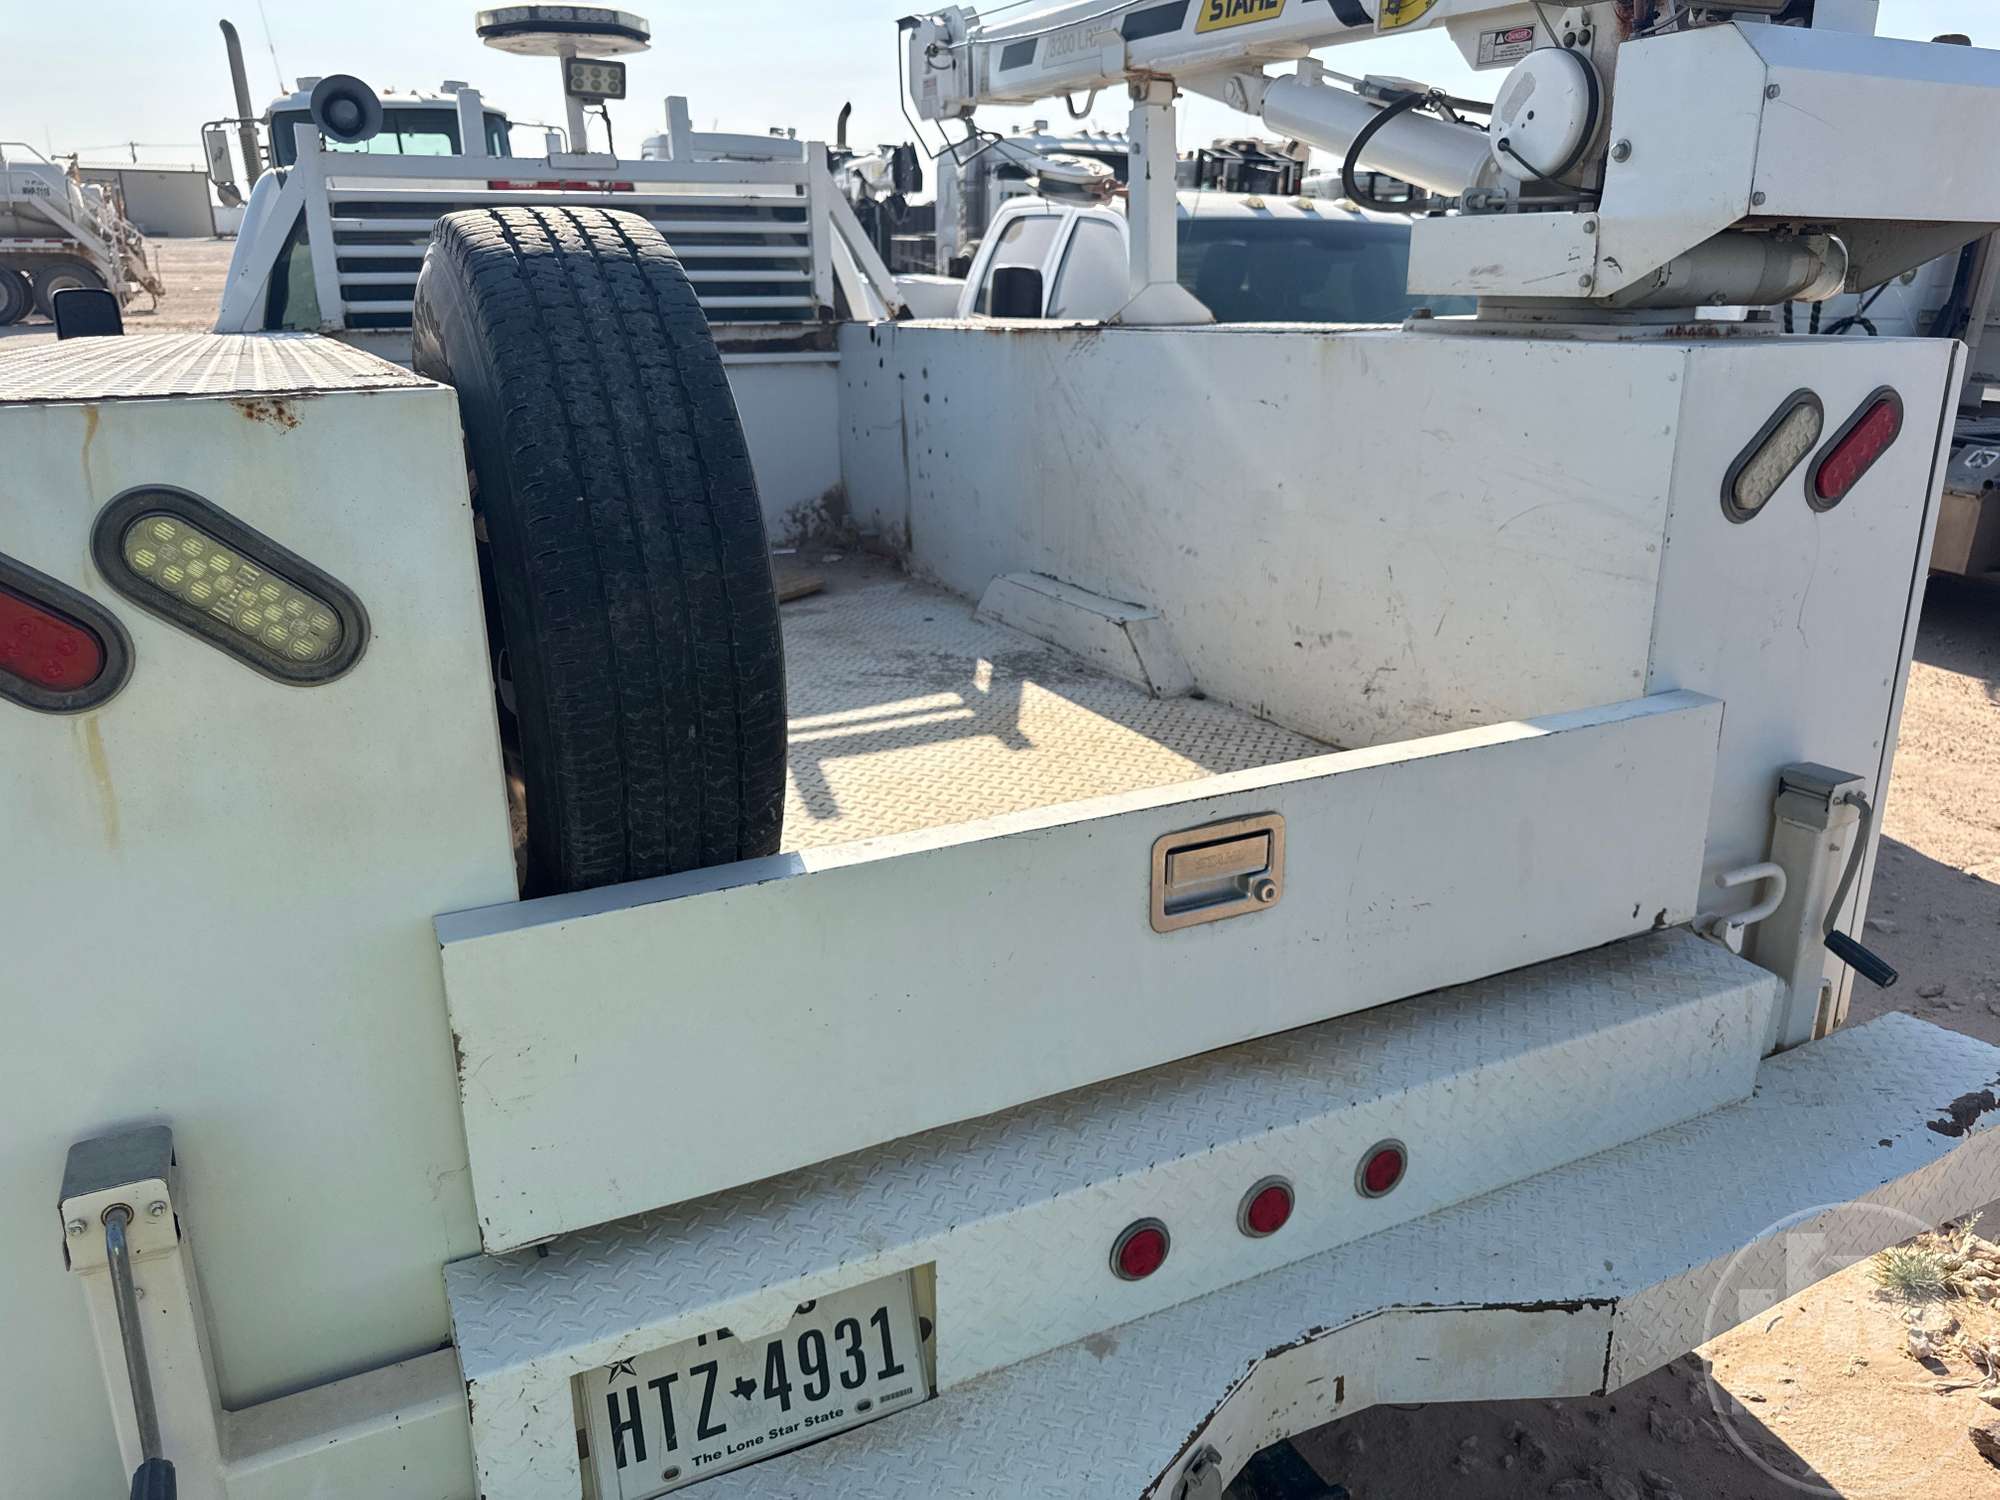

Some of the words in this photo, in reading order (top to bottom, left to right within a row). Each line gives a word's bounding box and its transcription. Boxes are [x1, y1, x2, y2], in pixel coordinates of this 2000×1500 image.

[606, 1360, 727, 1469] HTZ
[763, 1306, 905, 1412] 4931
[692, 1449, 722, 1467] The
[726, 1432, 764, 1456] Lone
[769, 1423, 800, 1440] Star
[804, 1407, 844, 1427] State
